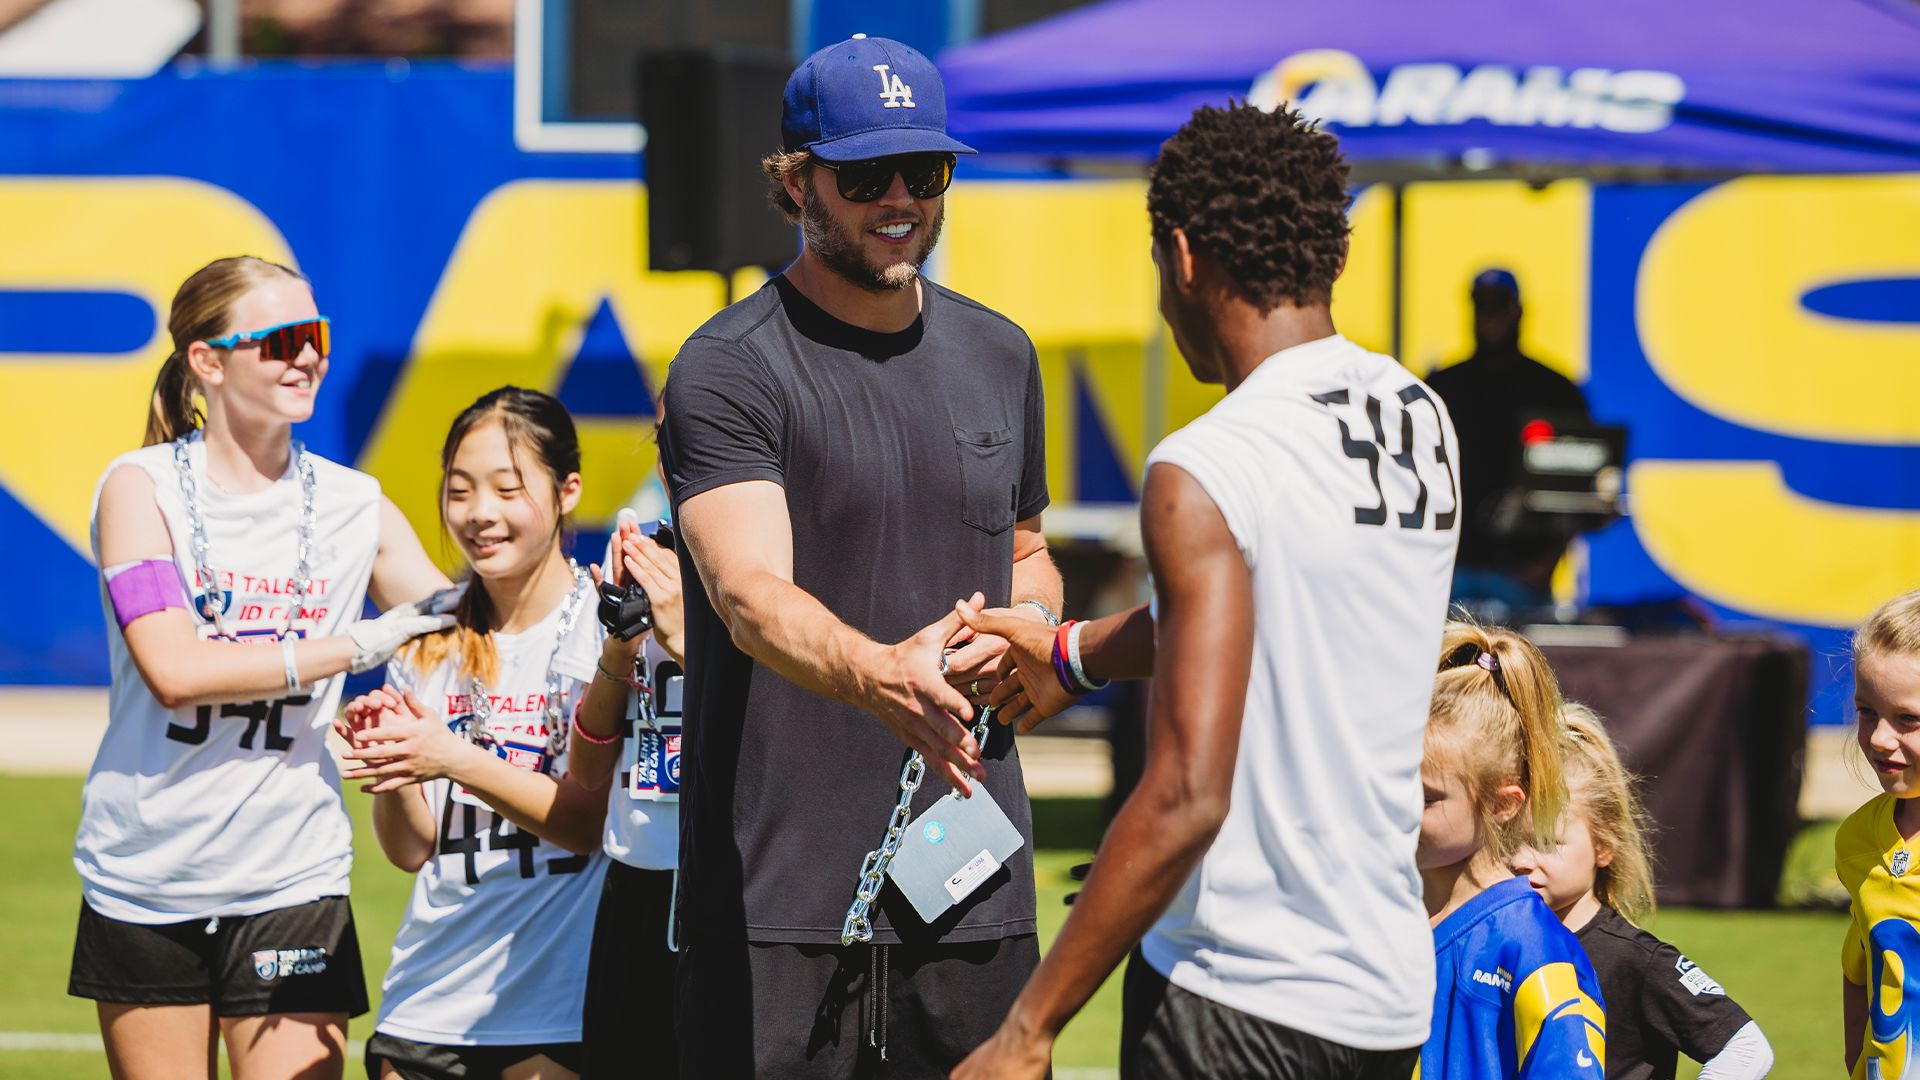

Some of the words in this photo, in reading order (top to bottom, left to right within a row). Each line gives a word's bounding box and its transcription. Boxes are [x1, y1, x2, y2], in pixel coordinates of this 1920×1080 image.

[872, 64, 916, 108] LA
[486, 692, 570, 714] TALEN
[638, 733, 650, 785] TALENT
[439, 779, 591, 886] 44
[1472, 968, 1512, 995] RAMS
